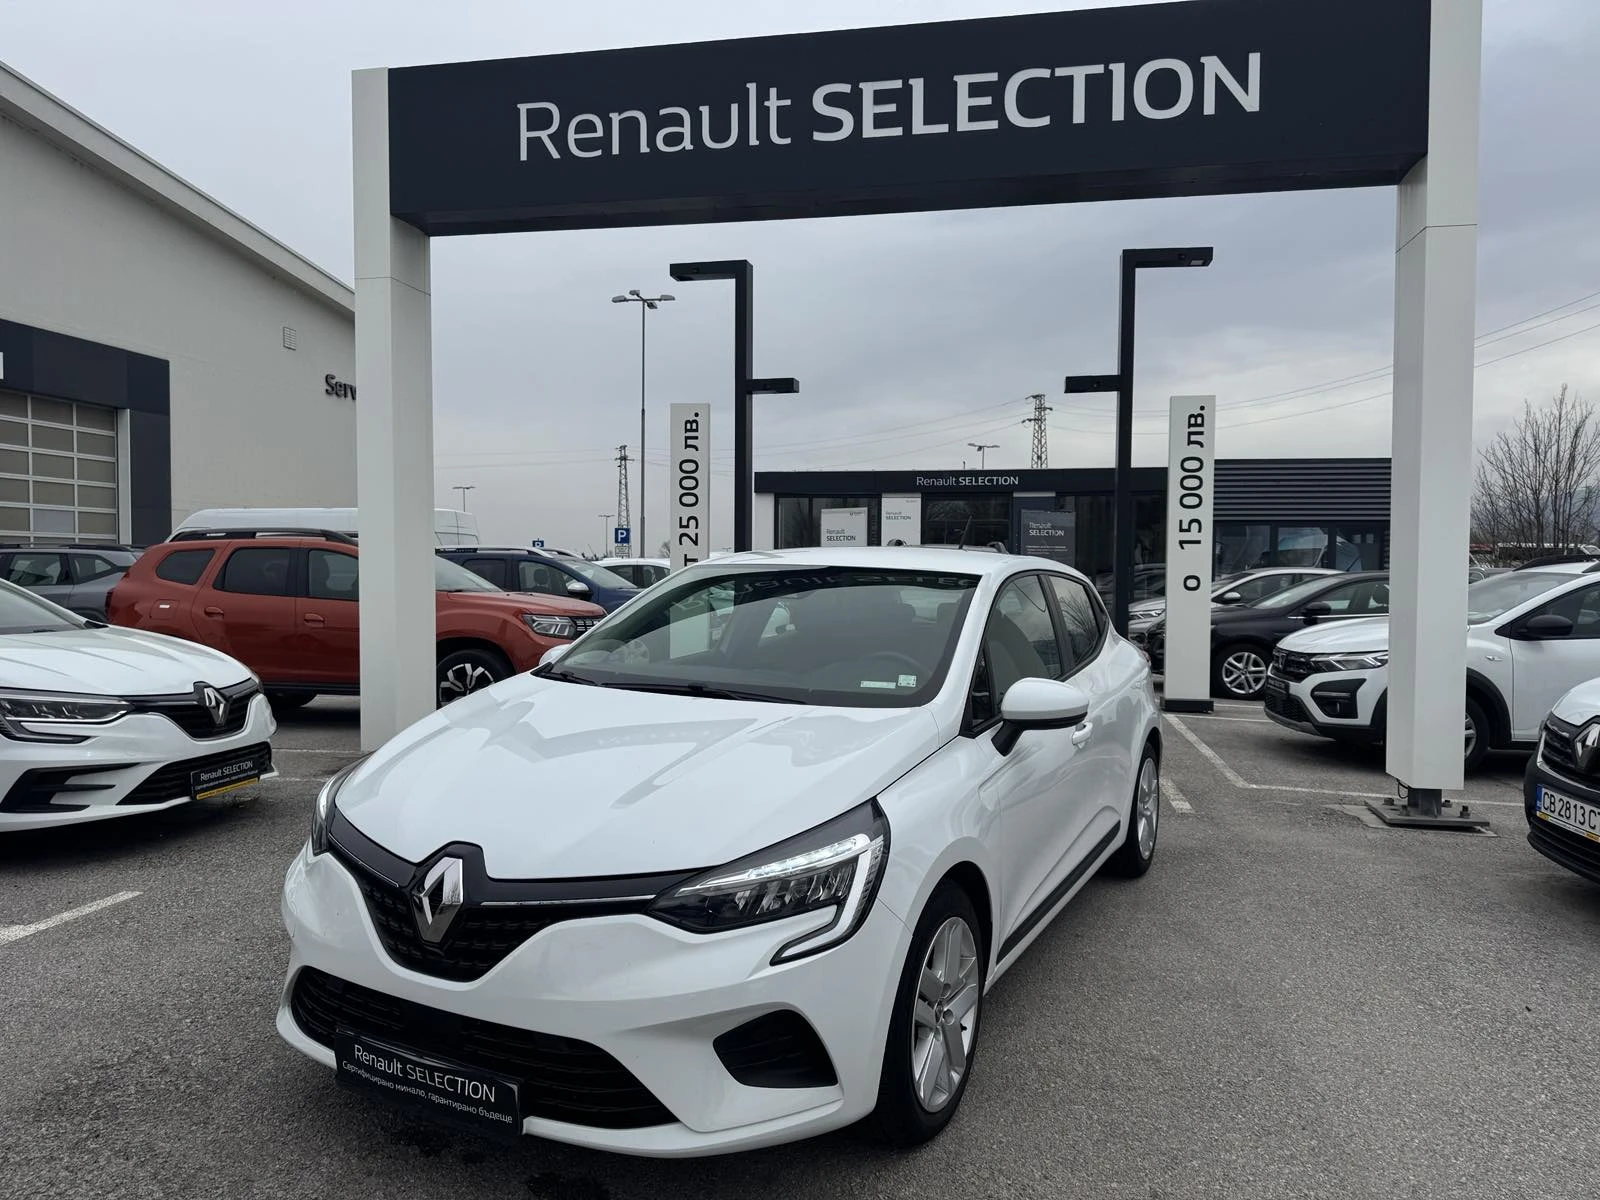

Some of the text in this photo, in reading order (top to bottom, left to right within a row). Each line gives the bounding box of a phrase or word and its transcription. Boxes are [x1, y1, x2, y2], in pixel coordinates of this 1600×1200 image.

[517, 52, 1261, 161] Renault SELECTION
[325, 373, 356, 400] Serv
[684, 412, 699, 451] лв.
[1187, 405, 1206, 448] лв.
[679, 459, 699, 507] 000
[916, 476, 1019, 486] Renault SELECTION
[1179, 456, 1204, 509] 000
[617, 529, 627, 542] P
[679, 515, 699, 546] 25
[1029, 529, 1065, 537] SELECTION
[1178, 518, 1202, 550] 15
[200, 768, 222, 781] Renault
[222, 760, 253, 776] SELECTION
[1543, 792, 1556, 813] CB
[1558, 798, 1586, 826] 2813
[354, 1044, 495, 1103] Renault SELECTION
[342, 1060, 513, 1124] Сертифицирано минало, гарантирано бъдеще
